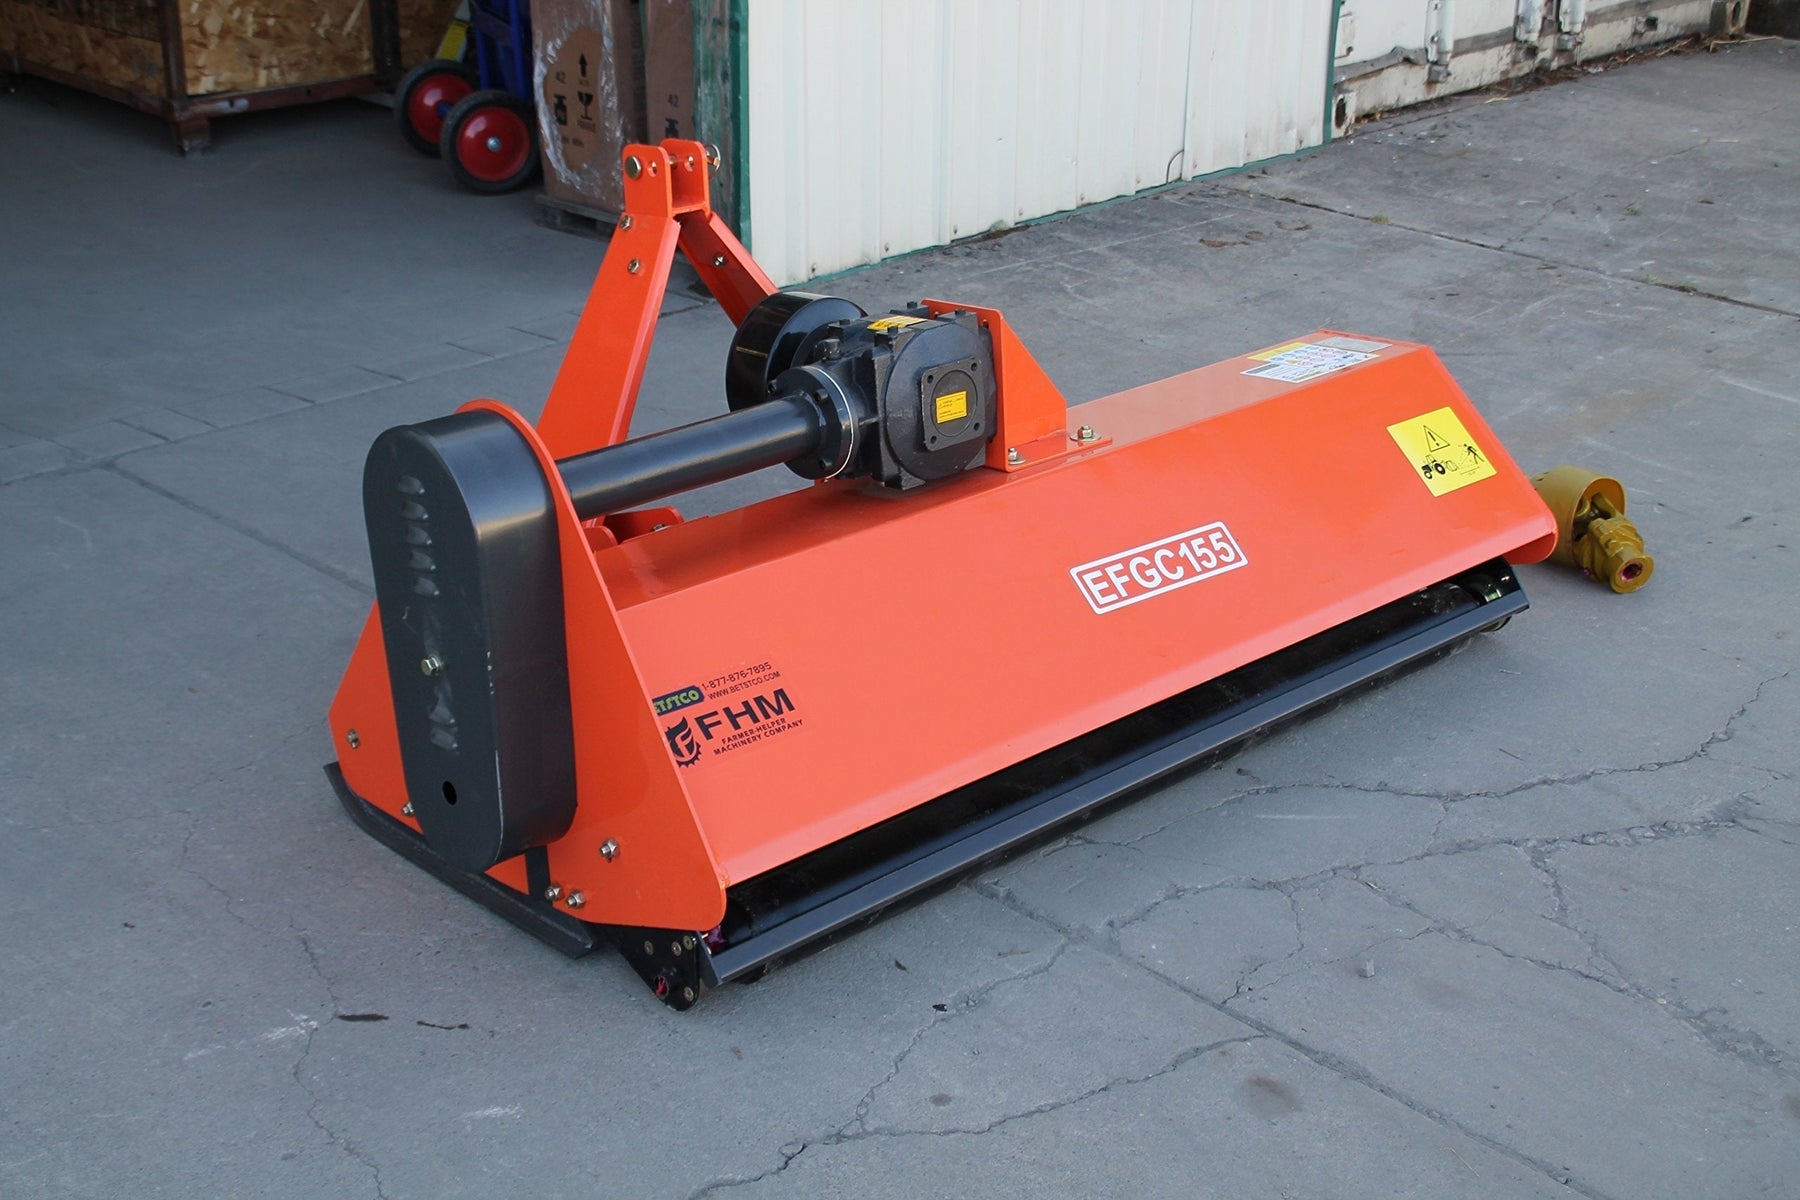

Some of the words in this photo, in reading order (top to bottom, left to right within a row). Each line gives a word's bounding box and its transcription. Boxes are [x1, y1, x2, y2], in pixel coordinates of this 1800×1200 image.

[1082, 531, 1236, 605] EFGC155
[701, 662, 772, 691] 1-877-876-7895
[705, 671, 781, 700] WWW.BETSTCO.COM
[694, 687, 795, 741] FHM
[713, 733, 762, 755] MACHINERY
[763, 719, 803, 738] COMPANY
[721, 717, 787, 745] FARMER-HELPER
